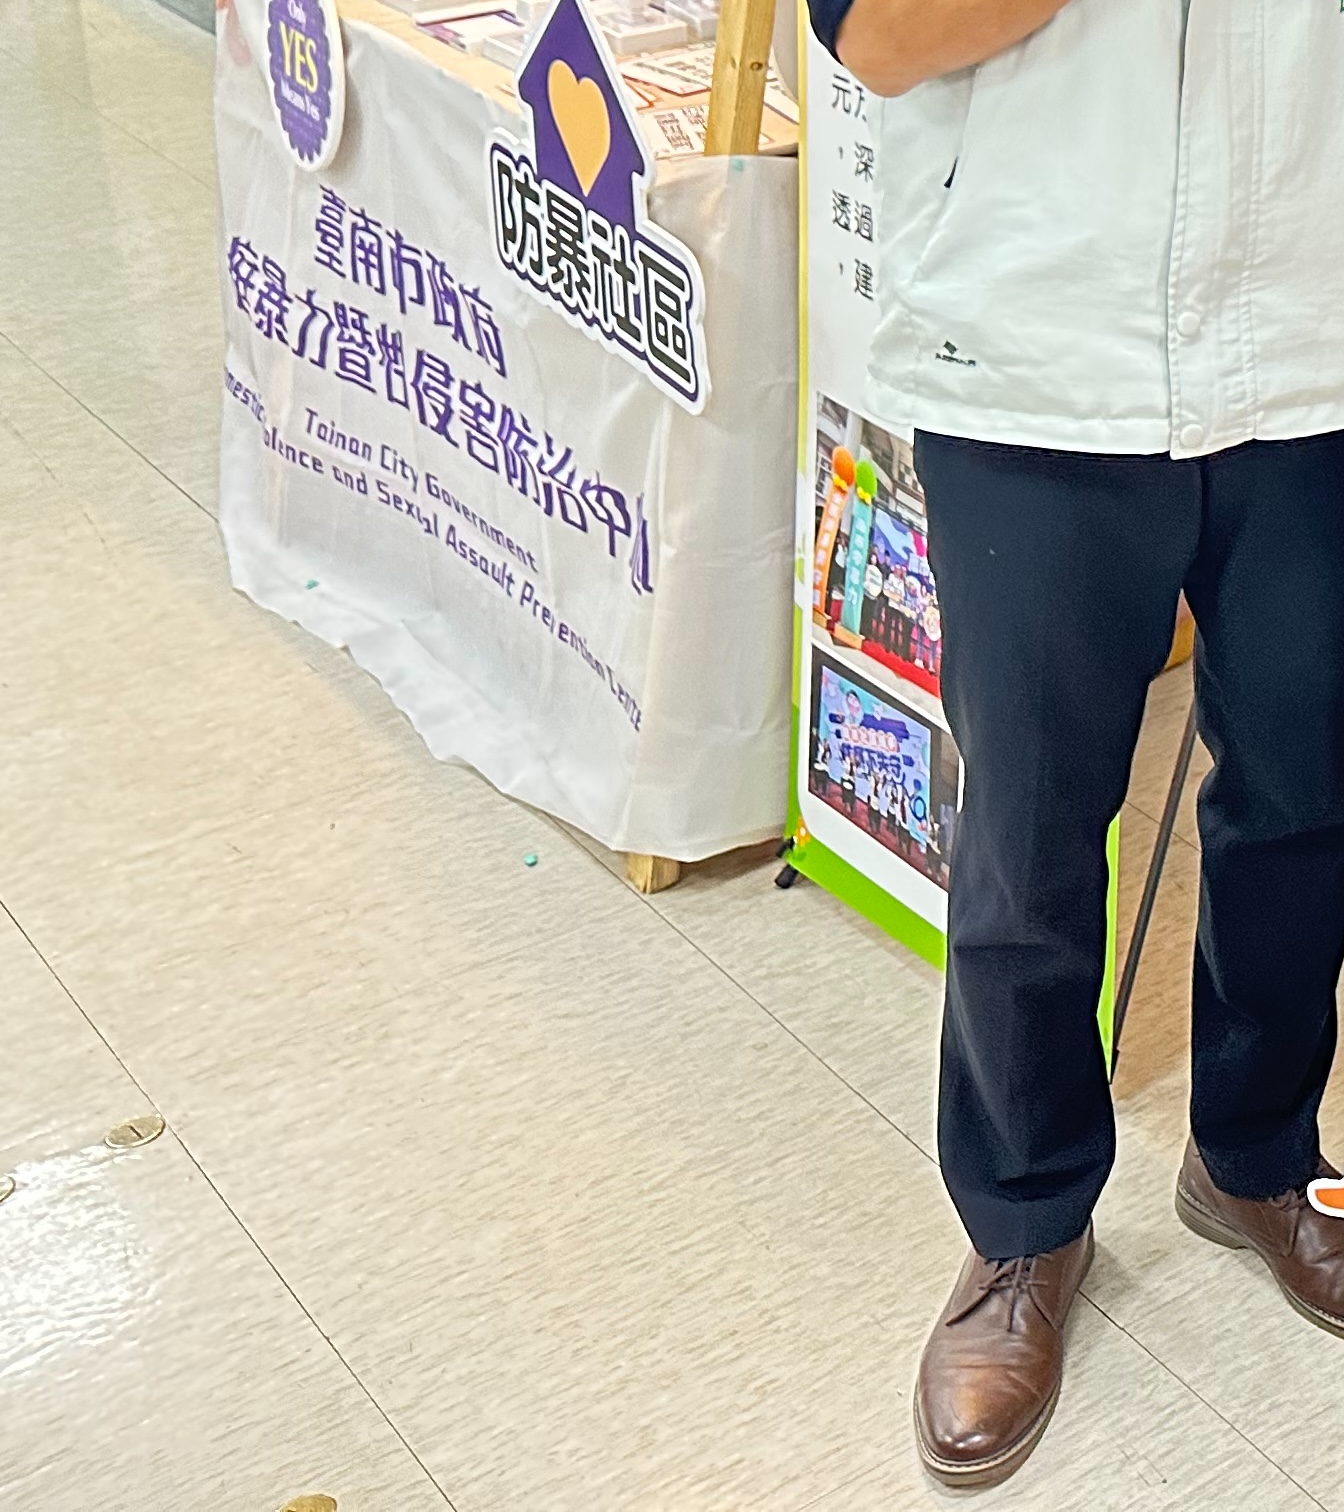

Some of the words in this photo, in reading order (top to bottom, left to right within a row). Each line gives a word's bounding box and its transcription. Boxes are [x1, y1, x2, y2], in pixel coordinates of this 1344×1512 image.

[279, 20, 319, 95] YES
[315, 185, 508, 378] 臺南市政府
[495, 160, 696, 393] 防暴社區
[305, 408, 372, 462] Tainan
[380, 444, 419, 493] City
[425, 473, 539, 574] Government
[333, 465, 368, 496] and
[446, 525, 514, 598] Assault
